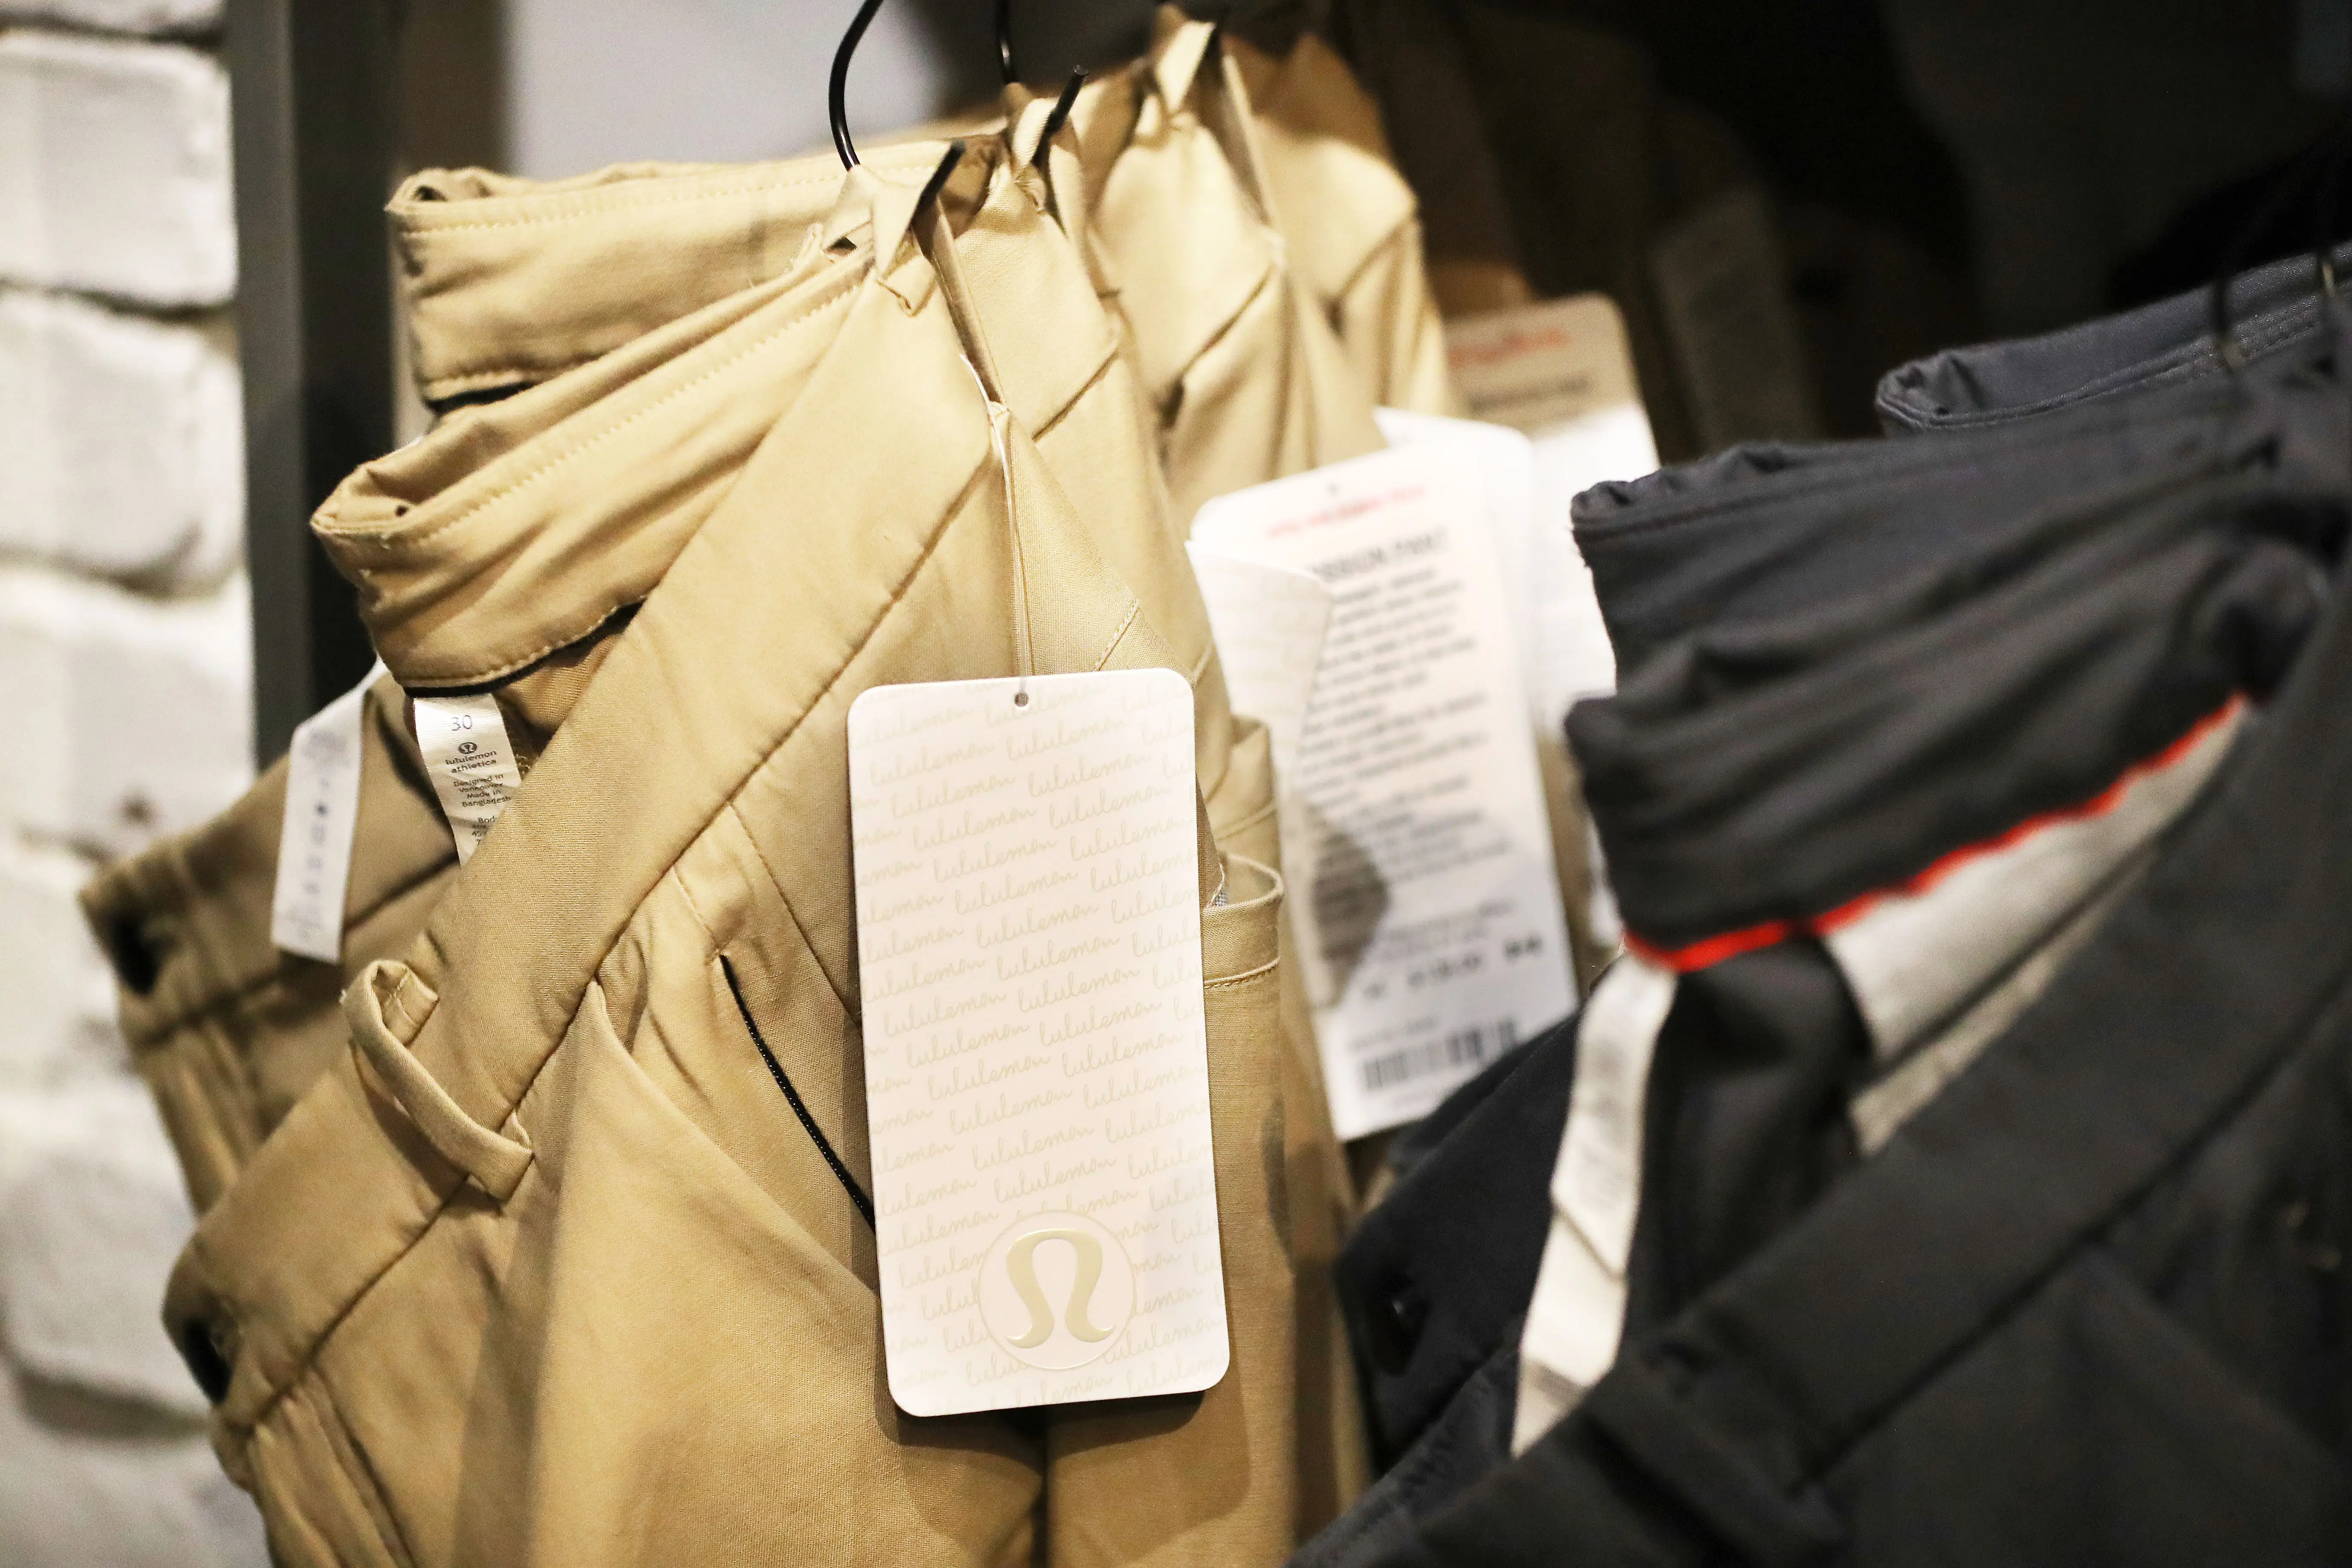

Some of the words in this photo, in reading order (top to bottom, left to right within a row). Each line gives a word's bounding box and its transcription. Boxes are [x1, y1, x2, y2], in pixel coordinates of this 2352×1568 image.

[452, 715, 472, 731] 30
[445, 750, 497, 765] lululemon
[451, 759, 496, 773] athletica
[453, 775, 492, 787] Designed
[462, 795, 511, 807] Bangladesh
[891, 775, 1015, 820] lululemon
[1027, 753, 1151, 797] lululemon
[478, 815, 496, 824] Bod
[912, 807, 1036, 852] lululemon
[1048, 785, 1172, 830] lululemon
[933, 839, 1057, 883] lululemon
[1069, 817, 1193, 861] lululemon
[954, 870, 1078, 915] lululemon
[975, 903, 1099, 948] lululemon
[996, 936, 1120, 981] lululemon
[883, 992, 1007, 1037] lululemon
[1017, 968, 1141, 1013] lululemon
[906, 1024, 1029, 1069] lululemon
[1038, 1001, 1162, 1046] lululemon
[927, 1056, 1051, 1101] lululemon
[1060, 1033, 1184, 1078] lululemon
[949, 1090, 1073, 1134] lululemon
[971, 1125, 1095, 1170] lululemon
[993, 1158, 1117, 1203] lululemon
